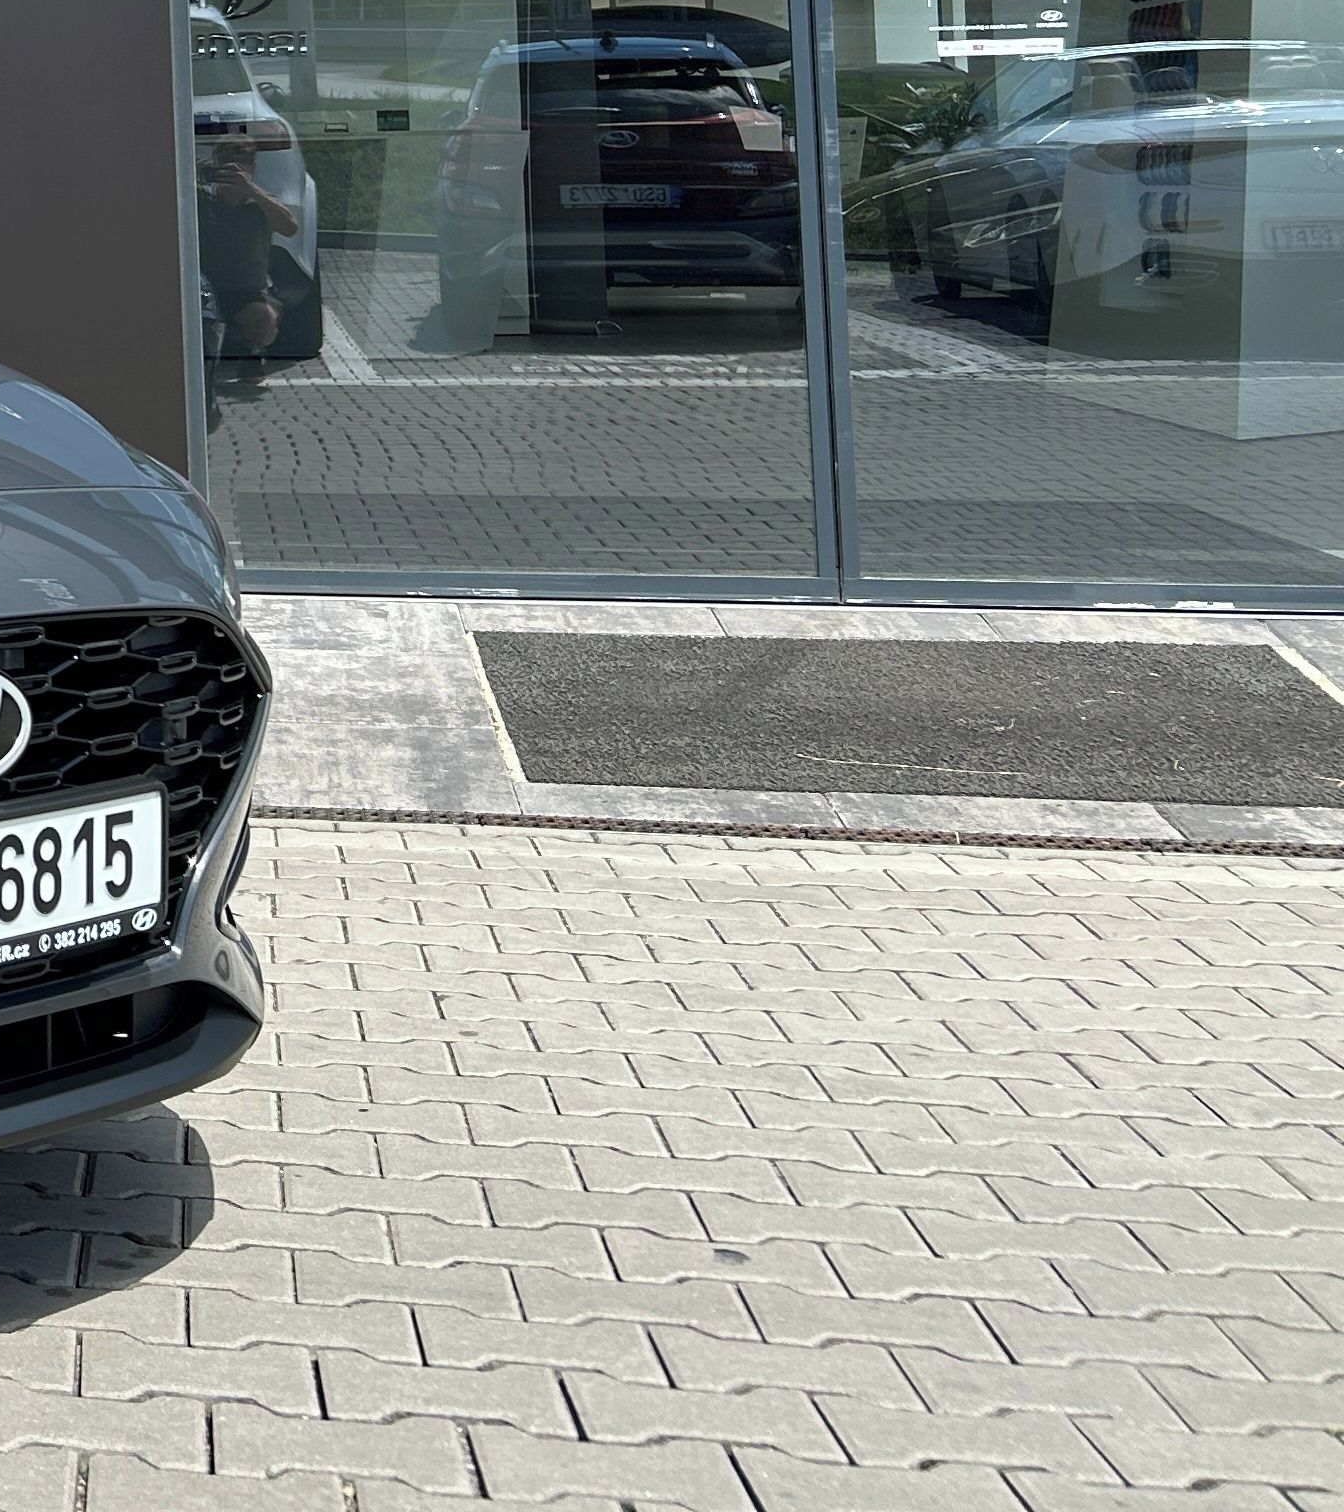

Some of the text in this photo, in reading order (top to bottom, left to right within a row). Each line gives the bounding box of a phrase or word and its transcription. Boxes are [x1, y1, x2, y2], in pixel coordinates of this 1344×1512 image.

[54, 929, 77, 950] 382
[77, 924, 99, 945] 214
[99, 919, 122, 940] 295
